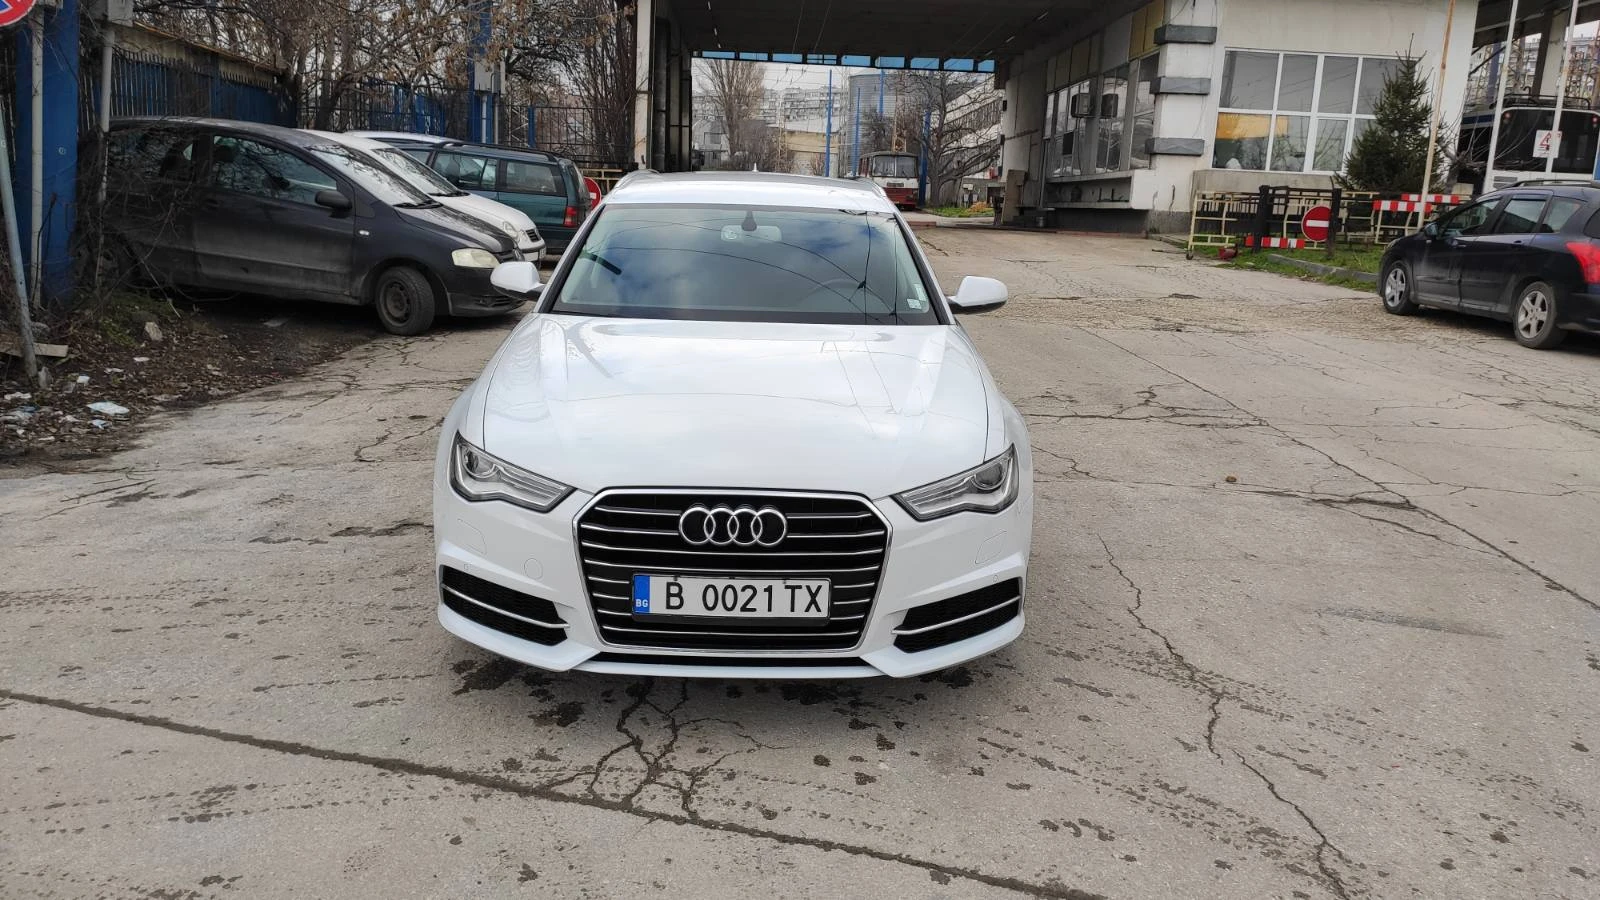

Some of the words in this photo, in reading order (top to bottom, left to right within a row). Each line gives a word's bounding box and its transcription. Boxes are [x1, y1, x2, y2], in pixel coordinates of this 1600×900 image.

[635, 598, 649, 608] BG
[665, 581, 684, 610] B
[702, 584, 773, 613] 0021
[784, 584, 823, 613] TX
